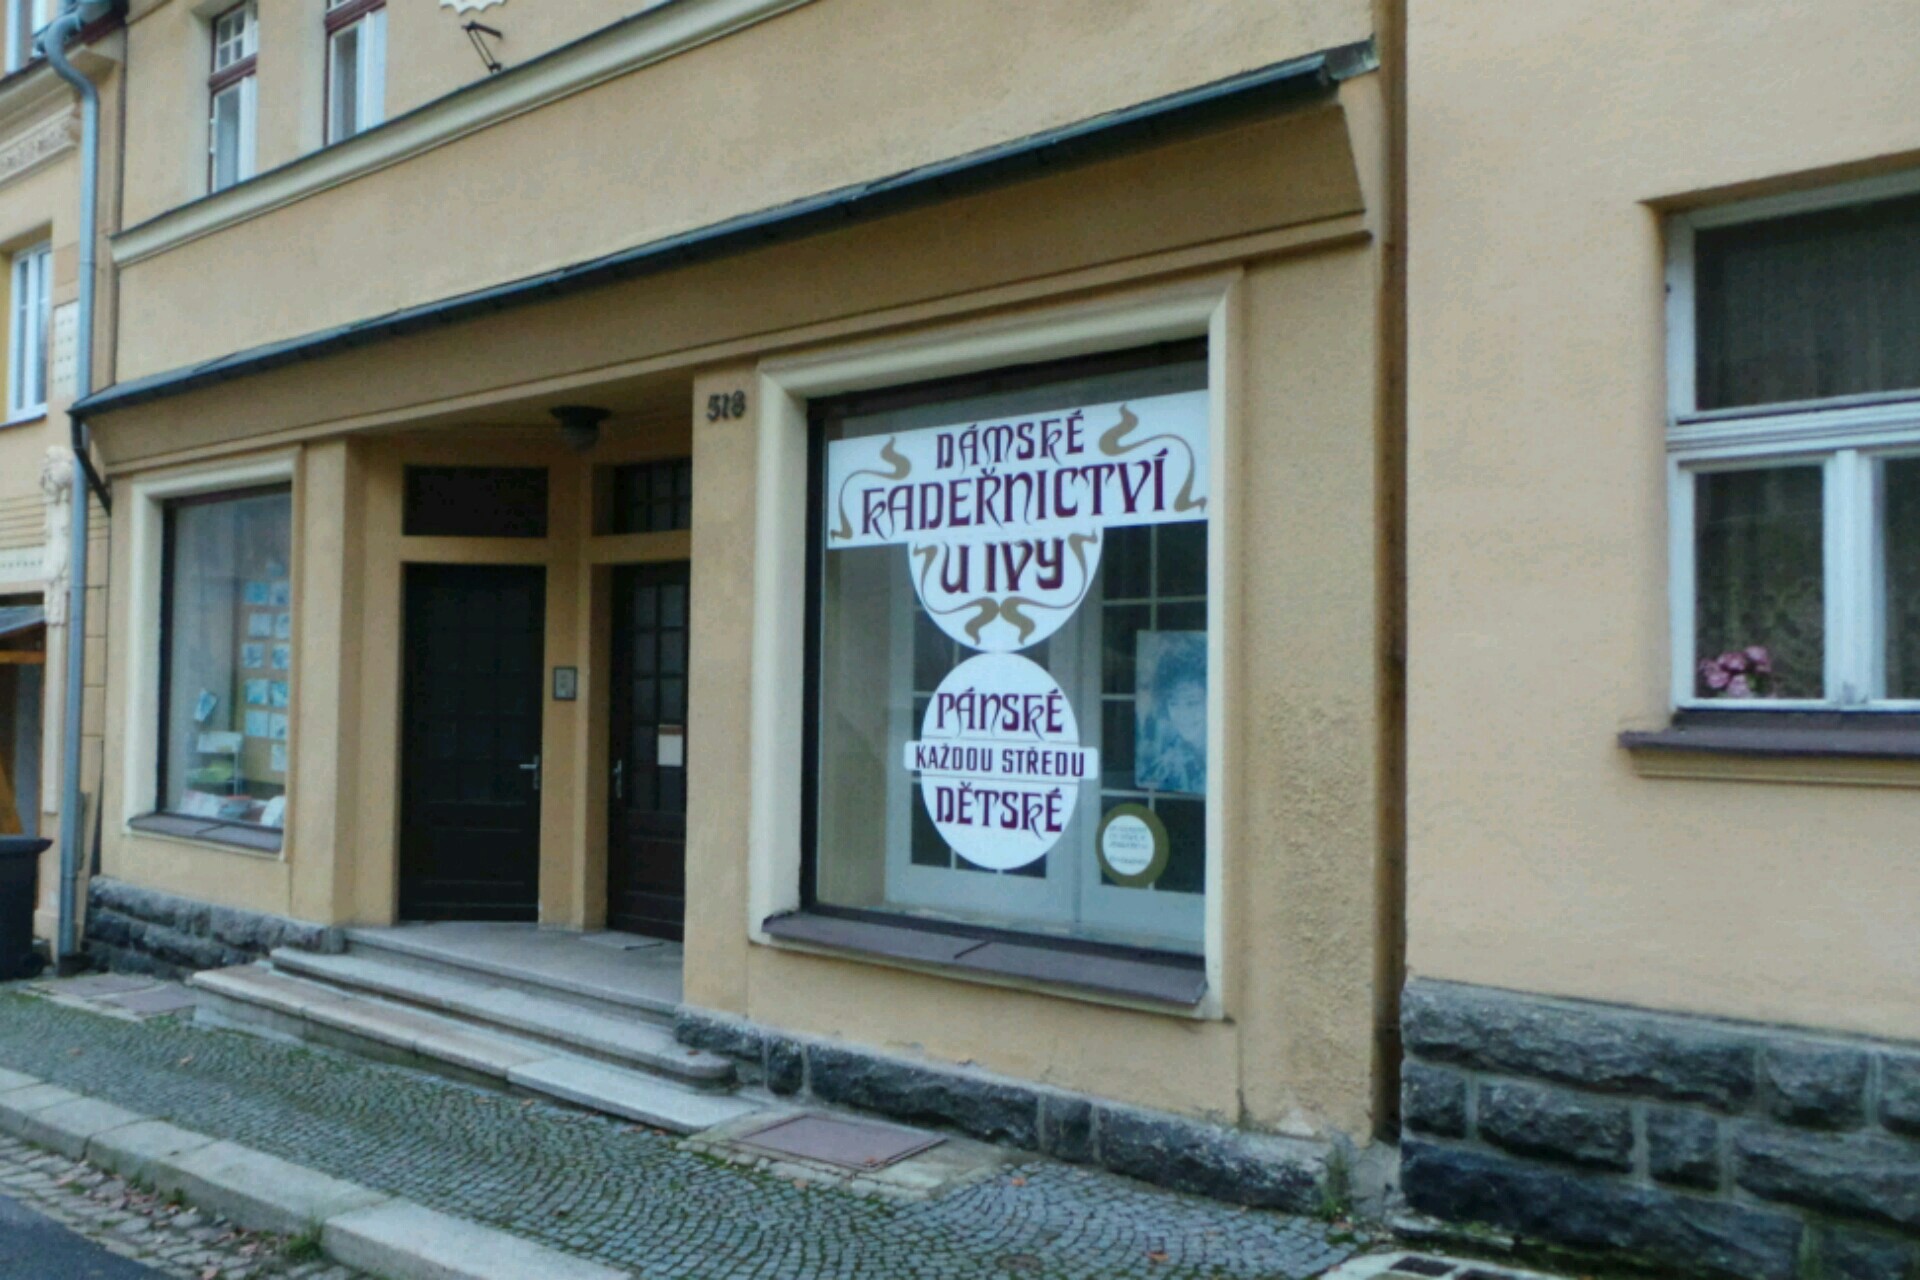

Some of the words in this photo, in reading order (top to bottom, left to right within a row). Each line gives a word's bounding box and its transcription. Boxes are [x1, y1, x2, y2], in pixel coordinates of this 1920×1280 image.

[936, 410, 1084, 471] DÁMSKÉ
[861, 448, 1168, 540] KADEŘNICTVÍ
[941, 542, 969, 593] U
[987, 539, 1064, 592] IVY
[937, 687, 1062, 740] PÁNSKÉ
[915, 744, 993, 772] KAŽDOU
[1002, 746, 1085, 777] STŘEDU
[935, 781, 1062, 840] DĚTSKÉ
